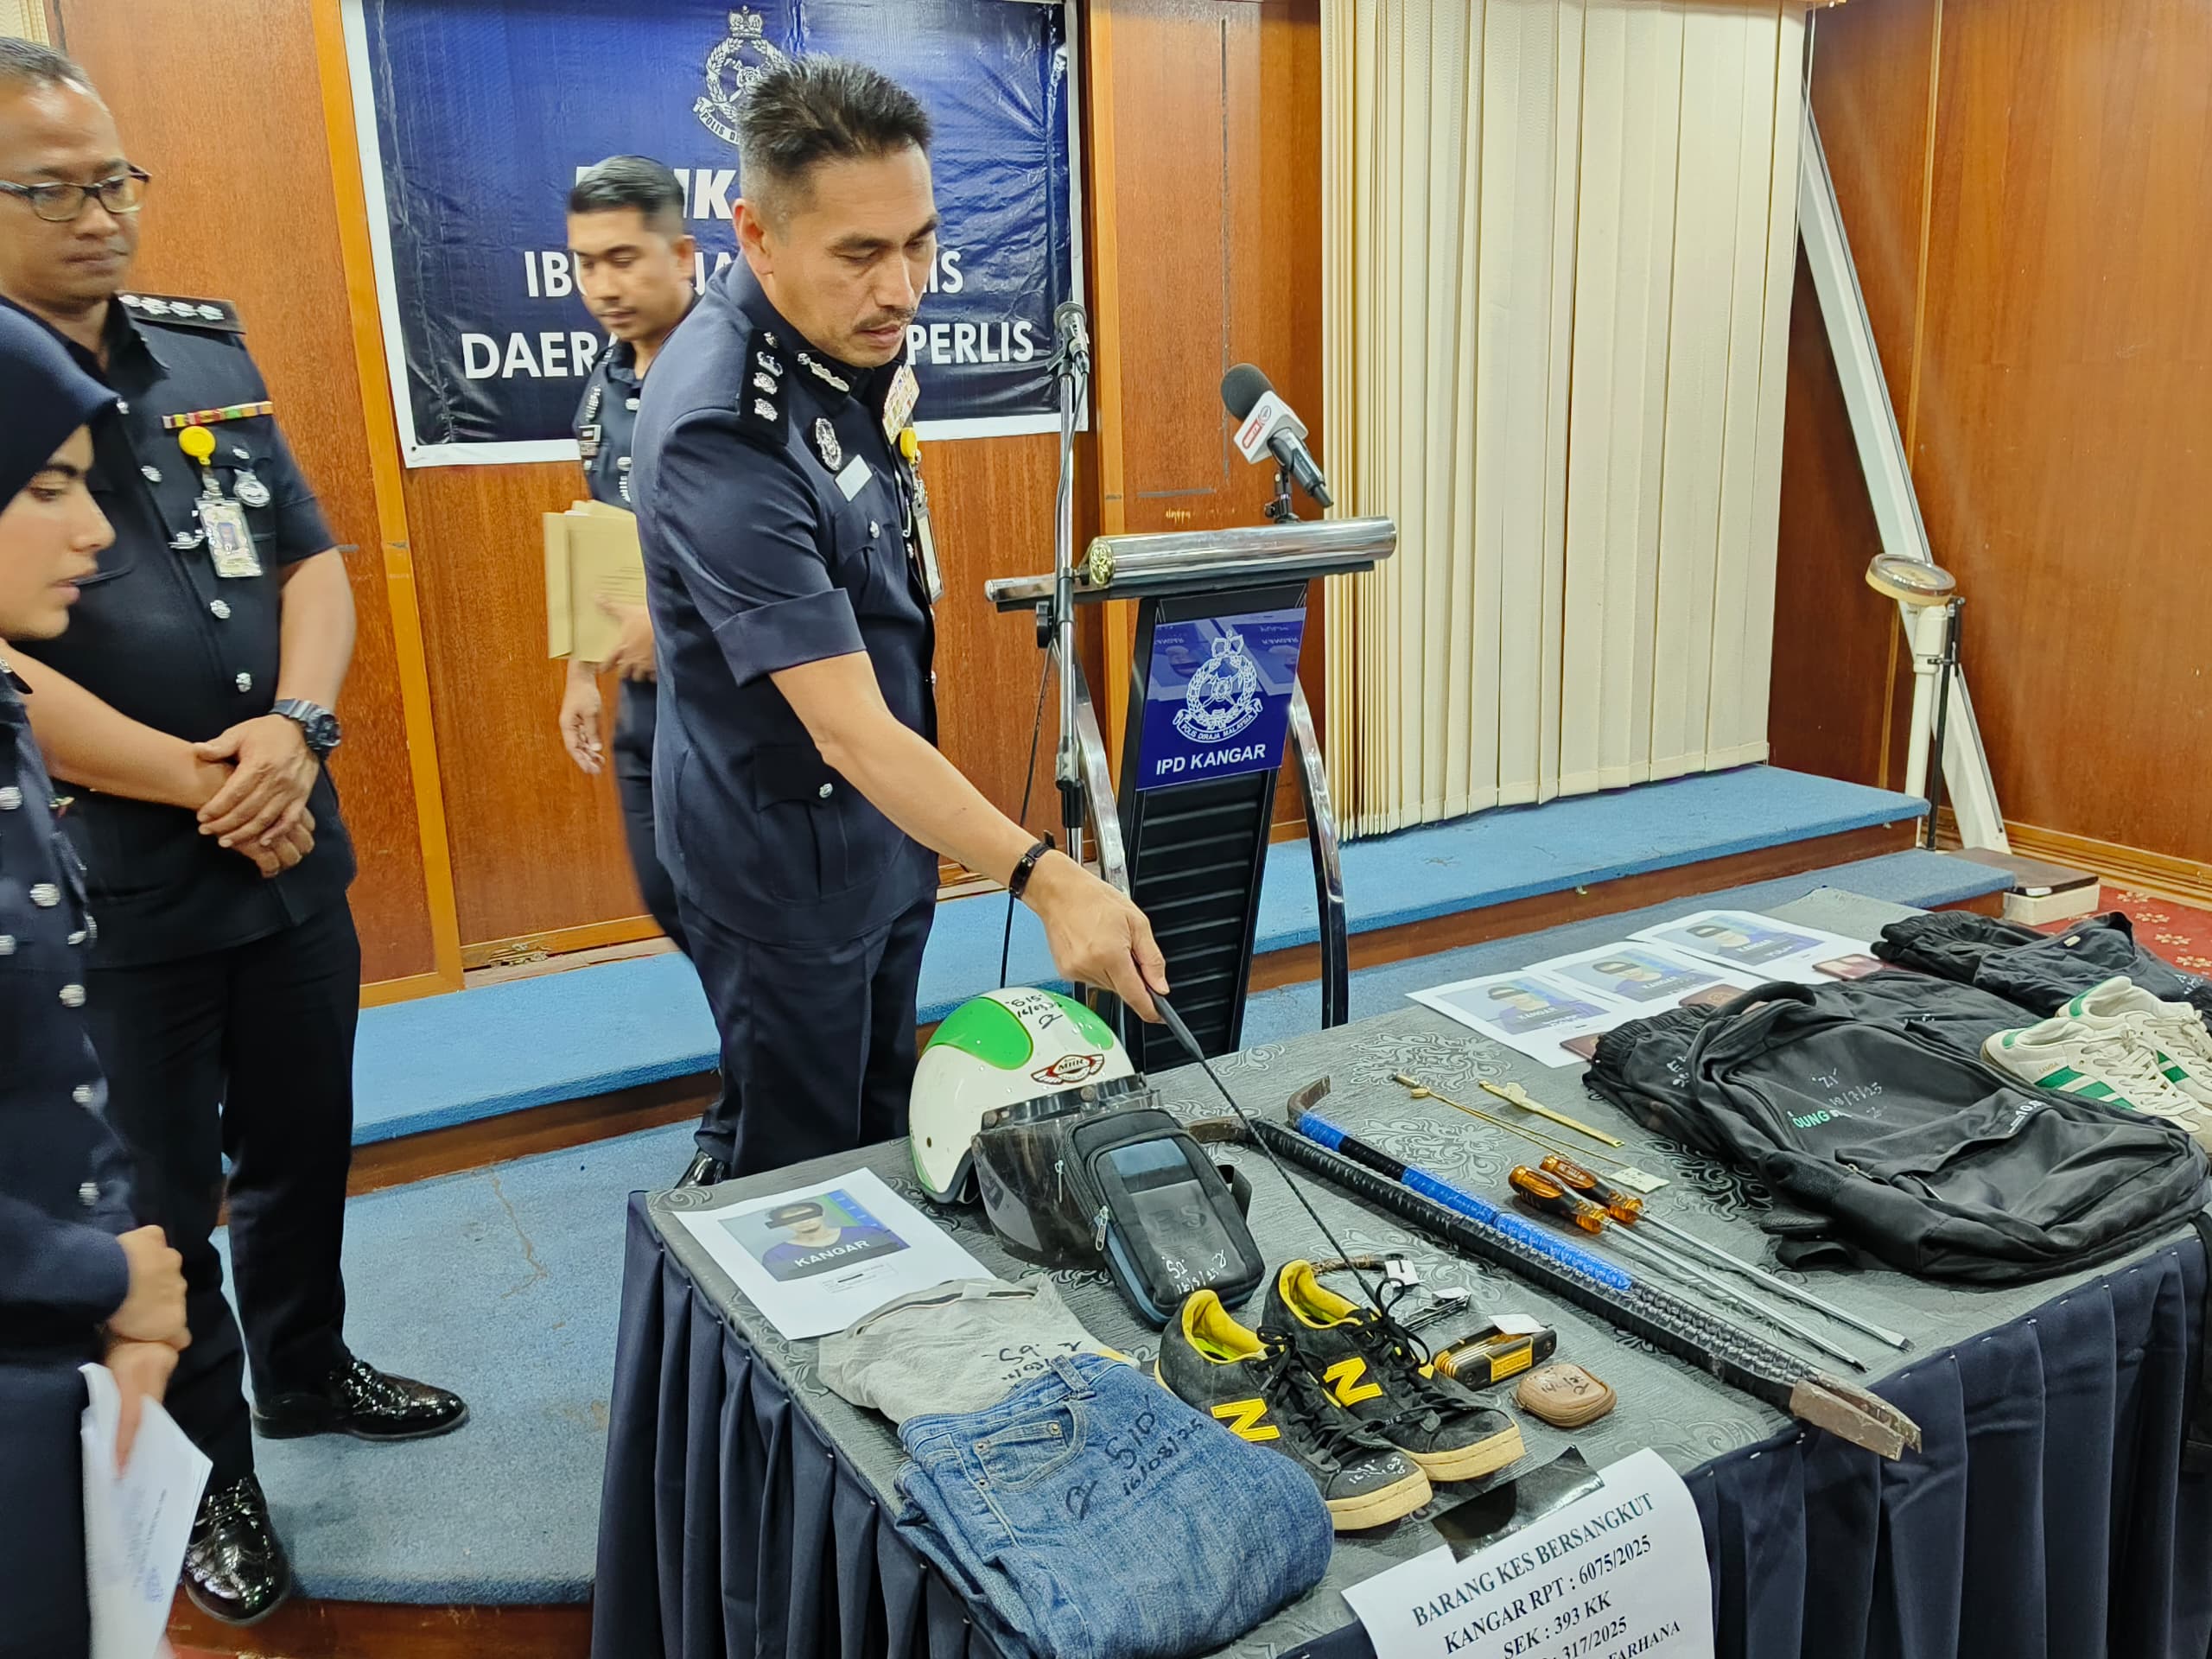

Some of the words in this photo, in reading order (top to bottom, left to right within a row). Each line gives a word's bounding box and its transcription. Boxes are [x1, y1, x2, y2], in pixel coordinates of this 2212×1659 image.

[701, 112, 725, 135] POLIS
[524, 251, 588, 297] IB
[461, 332, 619, 378] DAER
[906, 321, 1033, 365] PERLIS
[1180, 724, 1197, 738] POLIS
[1198, 732, 1220, 741] DIRAJA
[1224, 714, 1254, 737] MALAYSIA
[1156, 757, 1185, 775] IPD
[1191, 744, 1266, 770] KANGAR
[794, 1239, 870, 1268] KANGAR
[1411, 1572, 1495, 1628] BARANG
[1496, 1552, 1535, 1585] KES
[1535, 1492, 1655, 1566] BERSANGKUT
[1443, 1599, 1528, 1655] KANGAR
[1529, 1577, 1567, 1611] RPT
[1579, 1534, 1652, 1586] 6075/2025
[1503, 1628, 1541, 1659] SEK
[1554, 1607, 1580, 1635] 393
[1585, 1590, 1611, 1618] KK
[1561, 1616, 1628, 1659] 317/2025
